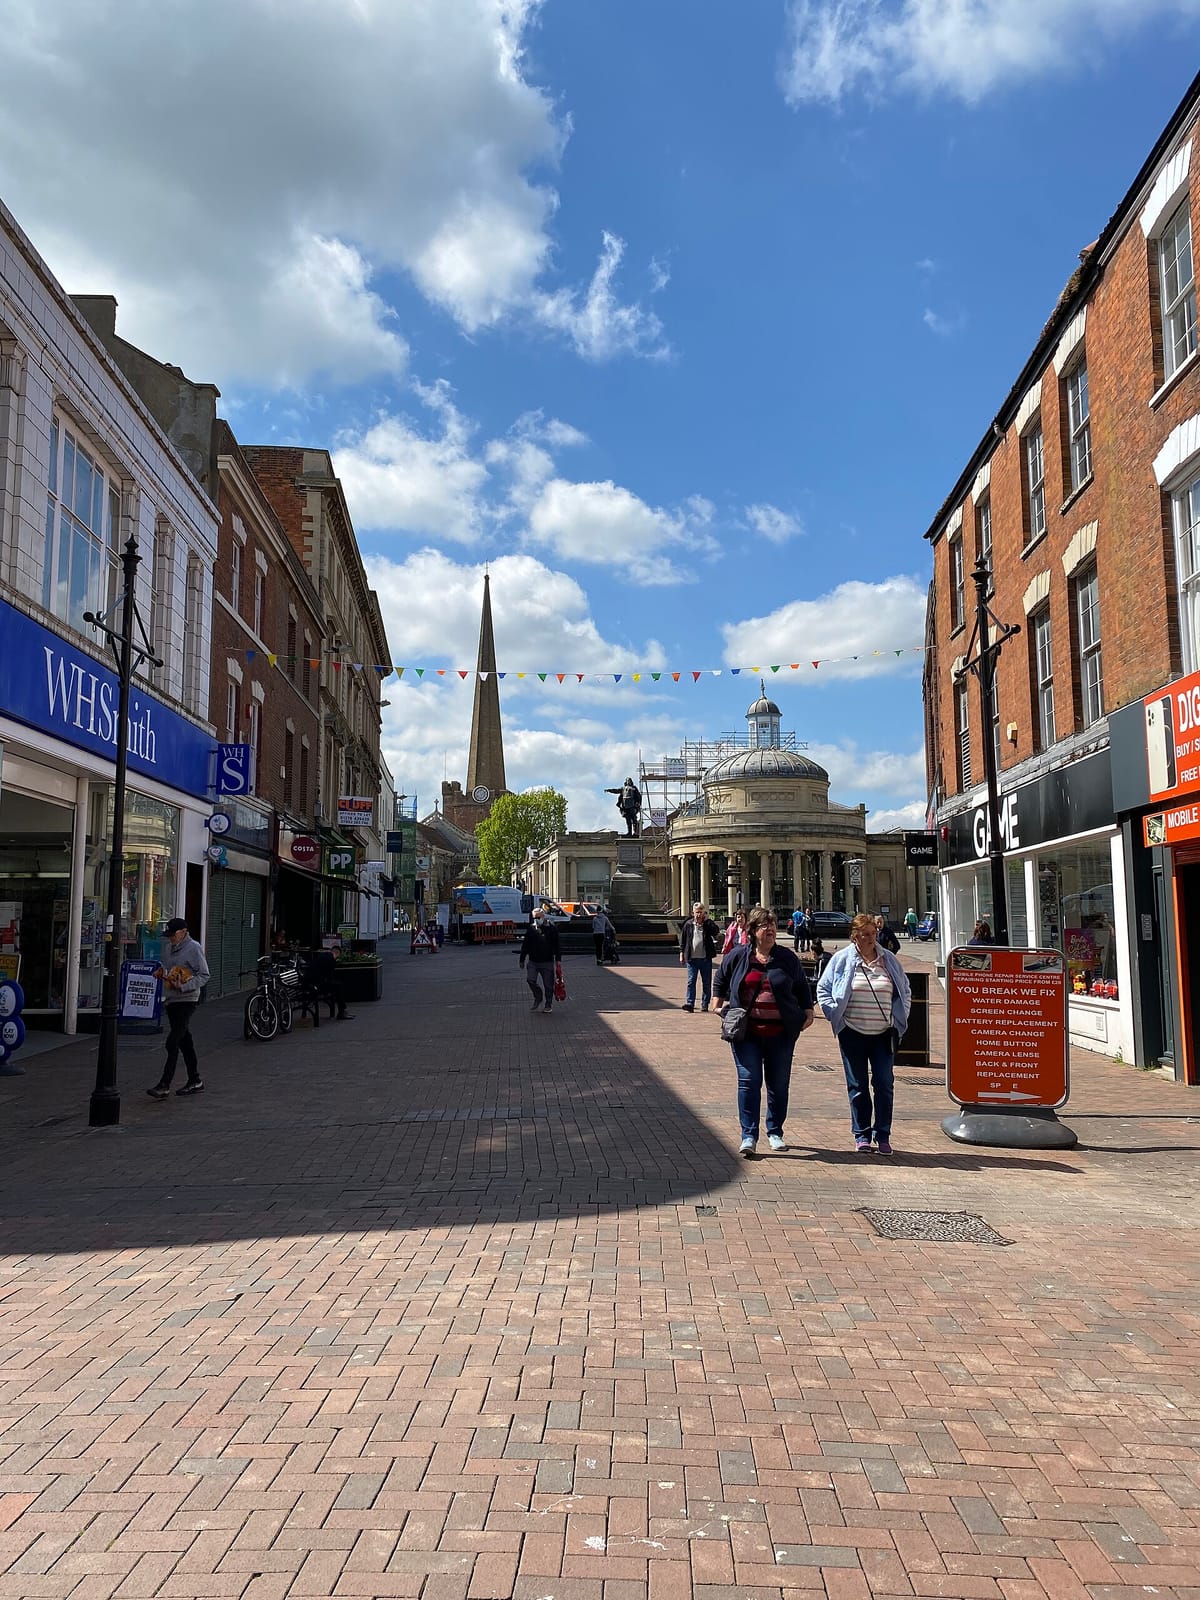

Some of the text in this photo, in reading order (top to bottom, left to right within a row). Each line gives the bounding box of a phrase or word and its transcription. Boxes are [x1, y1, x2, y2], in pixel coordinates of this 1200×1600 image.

[223, 747, 243, 757] WH
[1176, 742, 1190, 758] BUY
[221, 758, 244, 791] S
[1181, 766, 1198, 783] FREE
[1168, 807, 1198, 828] MOBILE
[982, 987, 1017, 995] BREAK
[995, 1019, 1058, 1027] REPLACEMENT
[976, 1071, 1040, 1079] REPLACEMENT
